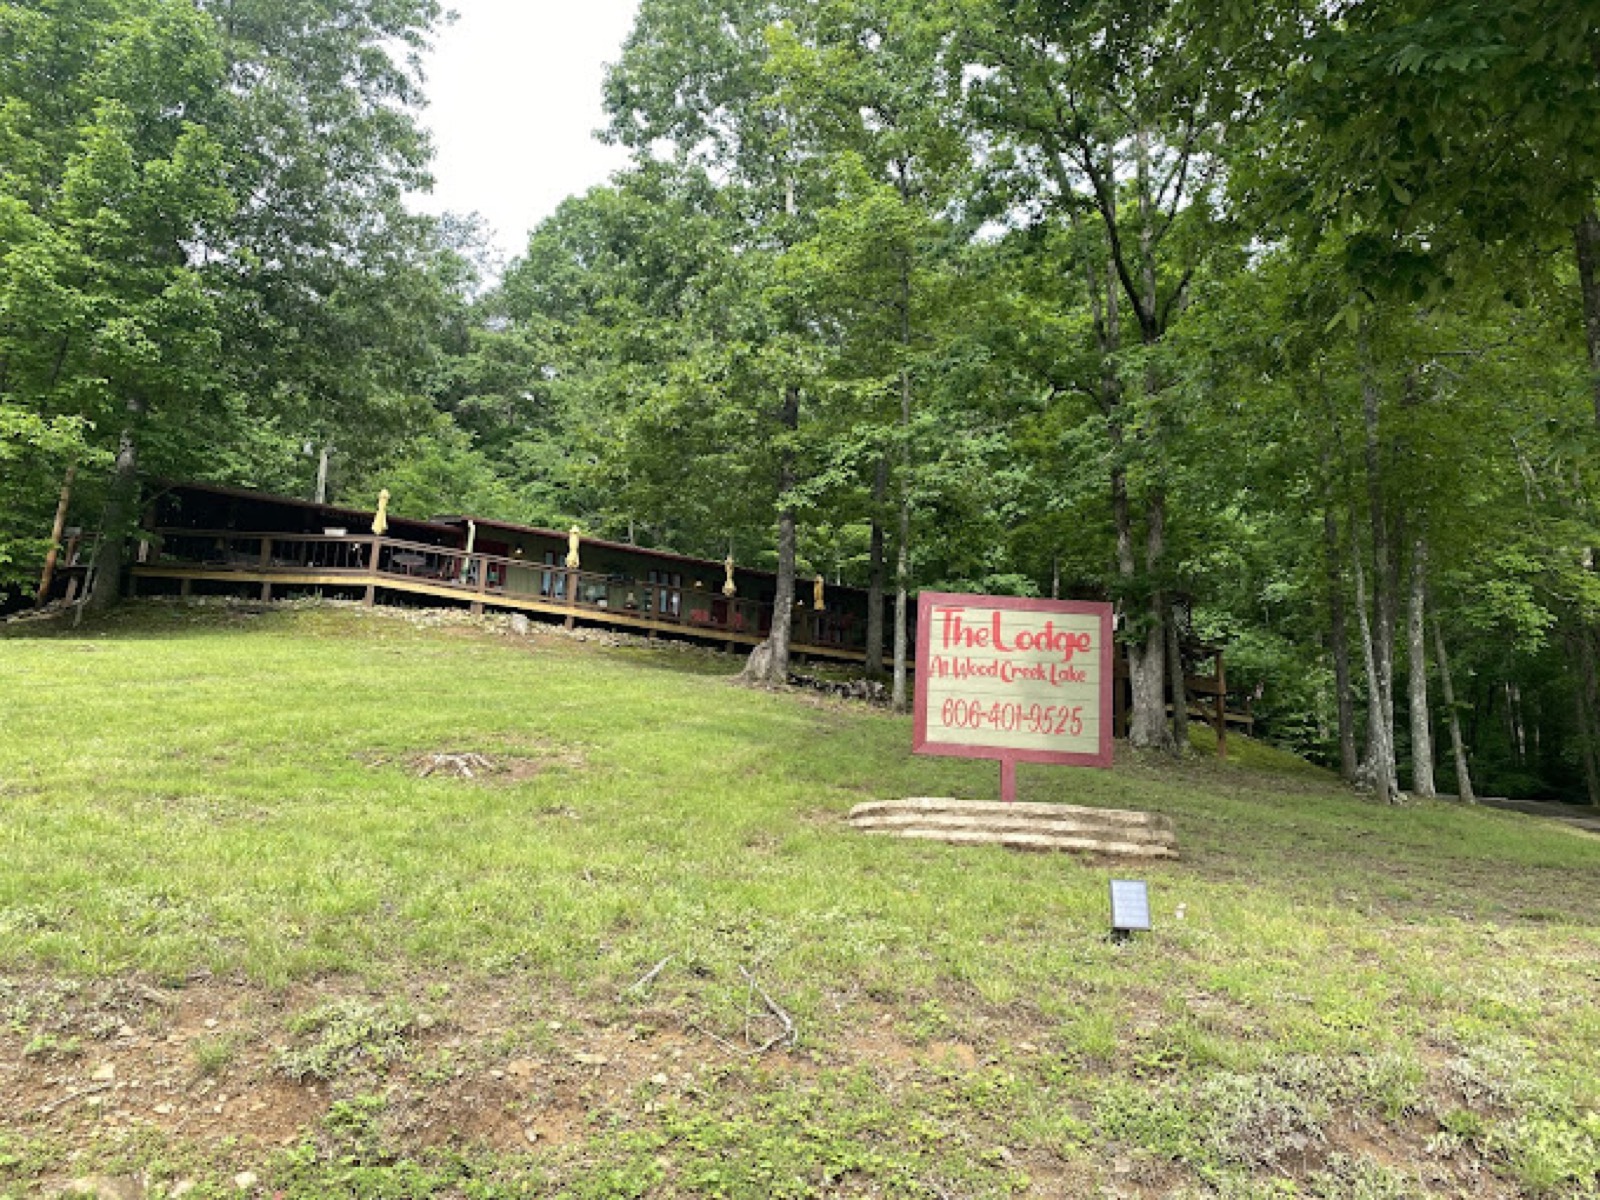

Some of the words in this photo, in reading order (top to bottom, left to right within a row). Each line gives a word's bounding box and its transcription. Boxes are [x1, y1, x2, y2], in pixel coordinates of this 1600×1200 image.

[934, 607, 989, 650] The
[992, 611, 1091, 664] Lodge
[952, 656, 999, 680] Wood
[1001, 661, 1048, 683] Creek
[1051, 664, 1086, 686] Lake
[941, 698, 1083, 736] 606-401-9525
